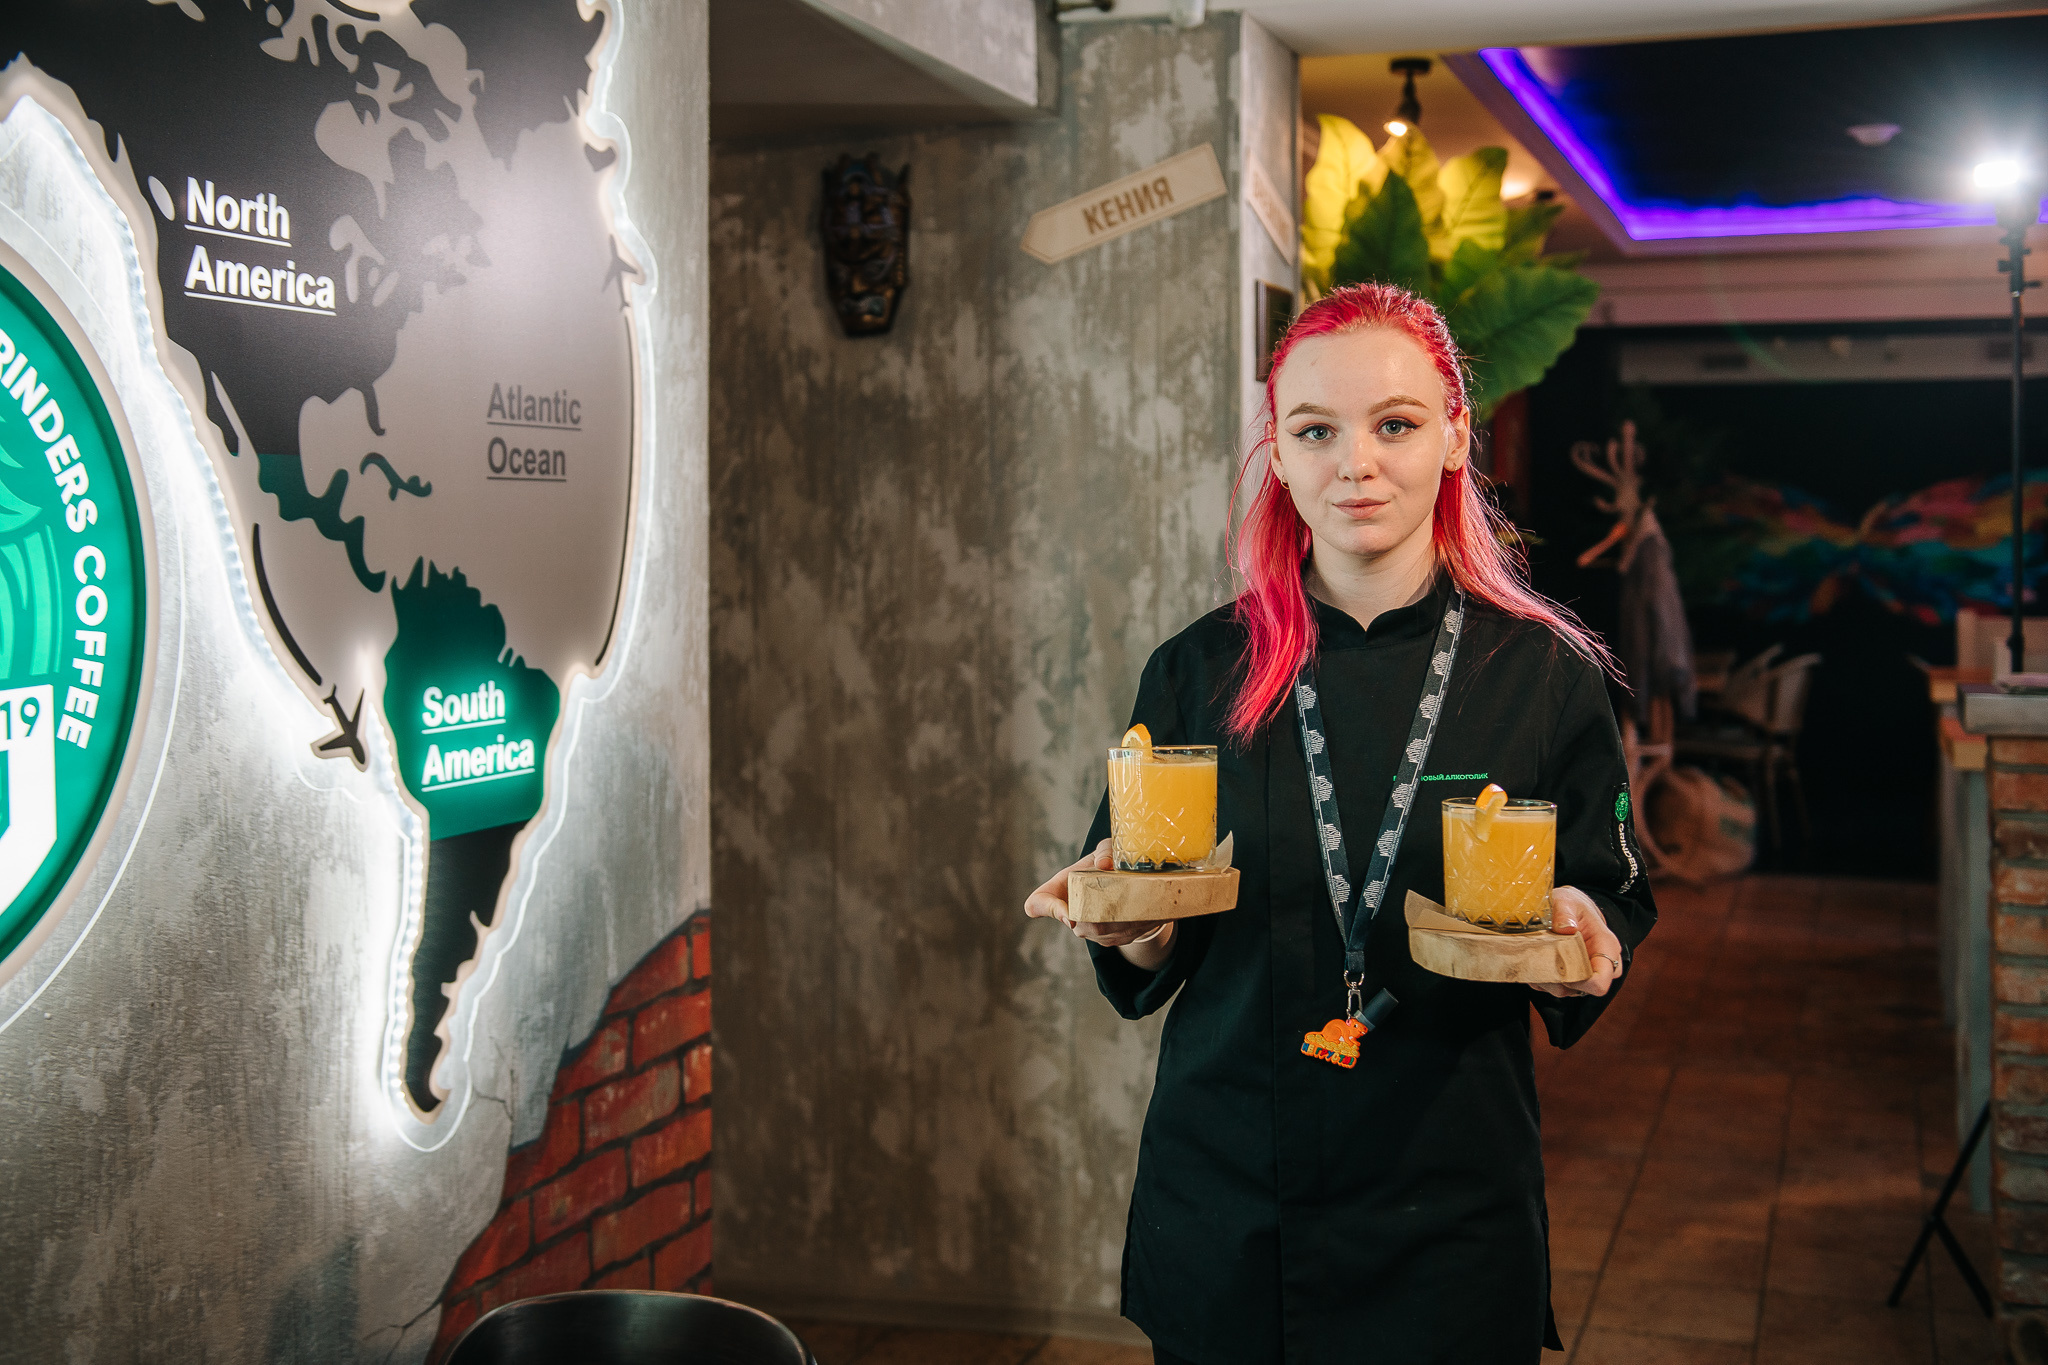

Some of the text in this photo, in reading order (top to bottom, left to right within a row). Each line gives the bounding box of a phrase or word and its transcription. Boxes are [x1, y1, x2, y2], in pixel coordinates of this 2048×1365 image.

[187, 176, 290, 240] North
[1082, 176, 1175, 235] КЕНИЯ
[184, 244, 336, 310] America
[486, 382, 581, 425] Atlantic
[487, 436, 566, 476] Ocean
[56, 545, 109, 749] COFFEE
[422, 680, 505, 727] South
[421, 734, 535, 785] America
[1445, 772, 1489, 781] АЛКОГОЛИК
[1618, 823, 1638, 878] GRINDERS
